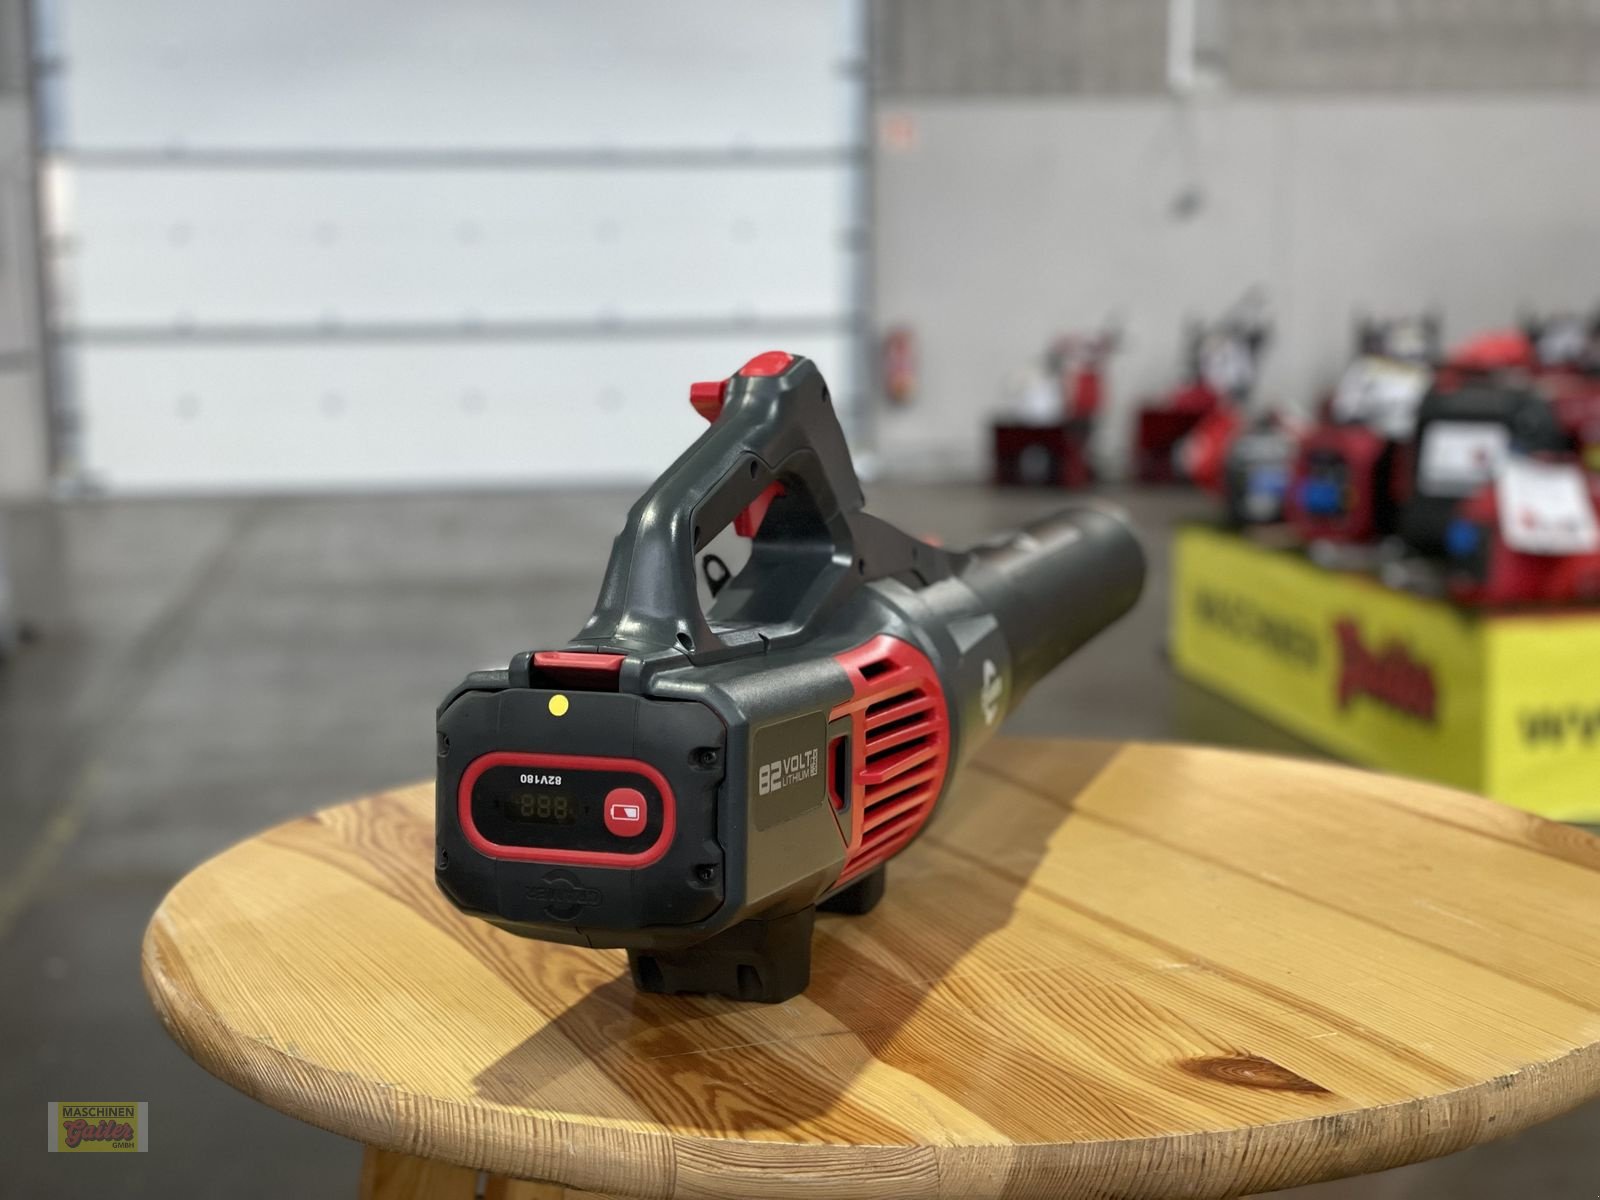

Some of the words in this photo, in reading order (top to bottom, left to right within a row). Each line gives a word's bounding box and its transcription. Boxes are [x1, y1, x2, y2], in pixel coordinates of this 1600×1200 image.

[520, 773, 562, 786] 82V180
[759, 760, 782, 796] 82
[783, 750, 813, 775] VOLT
[782, 768, 810, 787] LITHIUM
